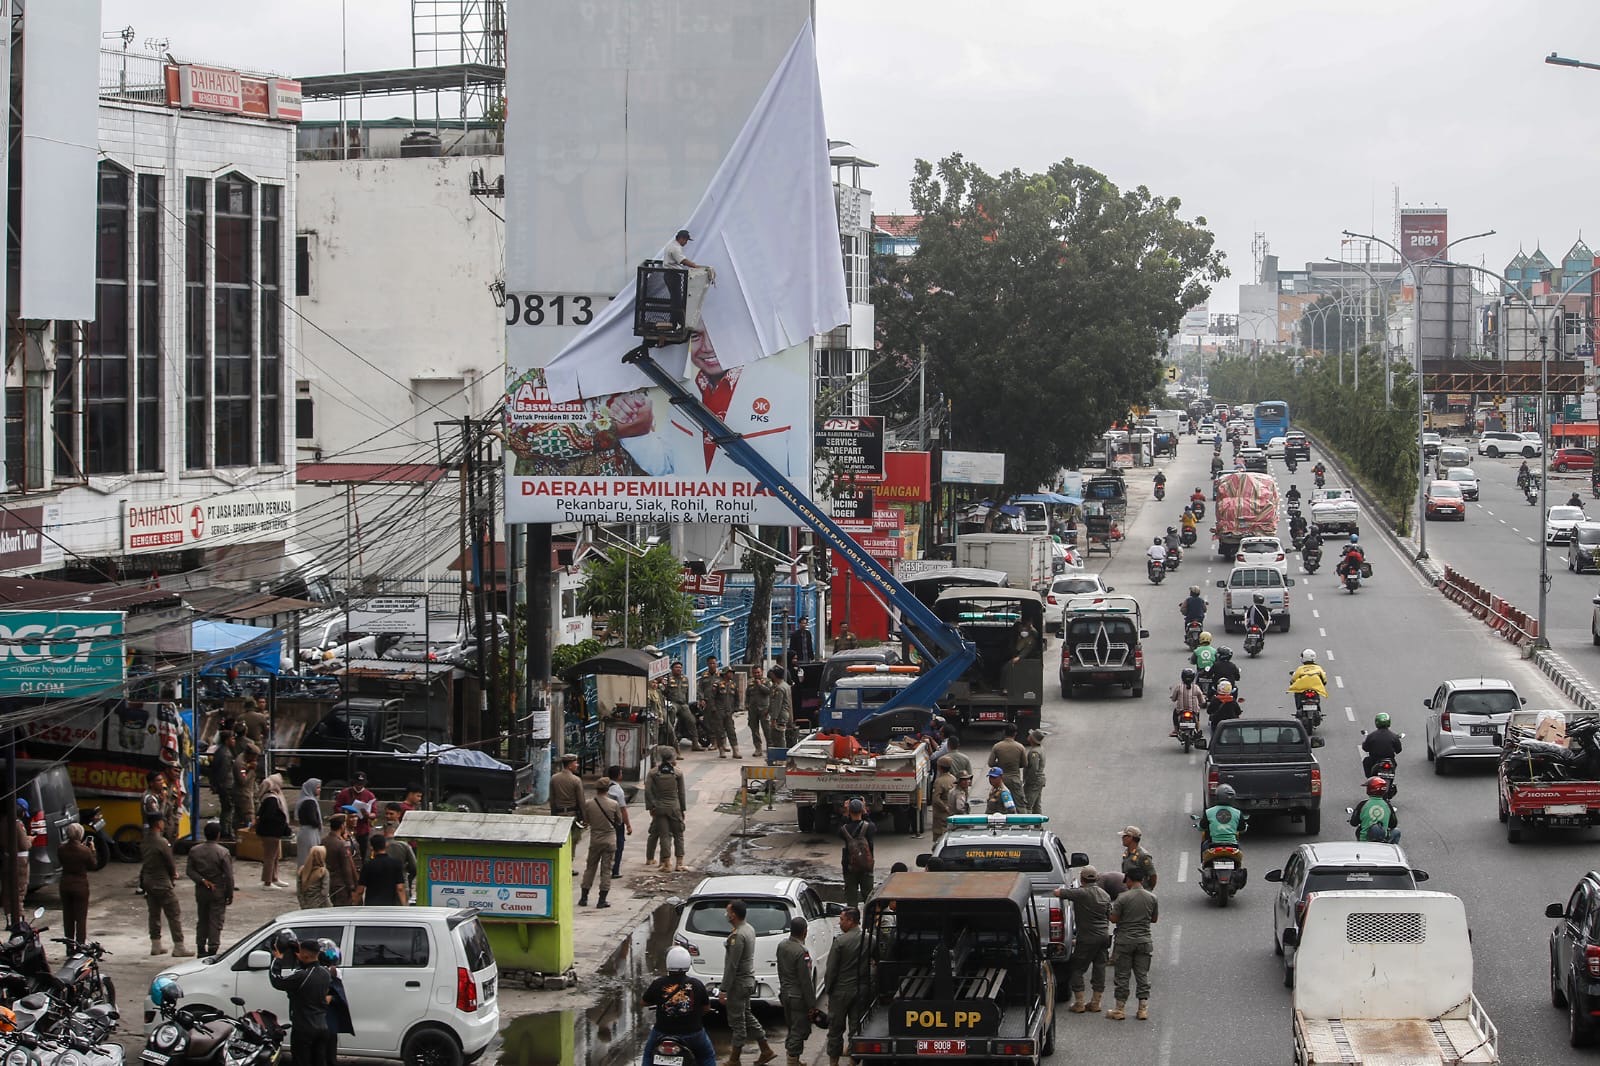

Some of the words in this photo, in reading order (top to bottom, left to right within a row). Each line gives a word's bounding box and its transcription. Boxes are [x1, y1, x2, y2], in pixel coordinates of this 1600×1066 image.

[192, 70, 239, 93] DAIHATSU
[1411, 235, 1438, 246] 2024
[506, 293, 593, 326] 0813
[518, 383, 549, 401] An
[517, 402, 581, 412] Baswedan
[750, 414, 769, 423] PKS
[826, 438, 857, 446] SERVICE
[838, 455, 865, 464] REPAIR
[521, 481, 607, 496] DAERAH
[613, 481, 726, 497] PEMILIHAN
[872, 485, 920, 497] UANGAN
[207, 506, 215, 519] PT
[217, 505, 232, 519] JASA
[233, 502, 264, 518] BARUTAMA
[265, 501, 292, 515] PERKASA
[557, 498, 631, 512] Pekanbaru,
[636, 498, 666, 512] Siak,
[671, 498, 708, 512] Rohil,
[716, 499, 758, 513] Rohul,
[129, 504, 183, 528] DAIHATSU
[565, 512, 611, 523] Dumai,
[616, 512, 679, 523] Bengkalis
[683, 512, 693, 523] &
[698, 512, 750, 524] Meranti
[778, 485, 797, 506] CALL
[799, 504, 831, 536] CENTER
[830, 533, 847, 551] PJU
[211, 523, 230, 536] SERVICE
[22, 530, 38, 550] Tour
[132, 535, 161, 547] BENGKEL
[162, 533, 182, 544] RESMI
[10, 664, 40, 675] explore
[42, 664, 72, 675] beyond
[430, 857, 490, 883] SERVICE
[494, 861, 550, 886] CENTER
[440, 887, 465, 895] ASUS
[501, 903, 532, 911] Canon
[905, 1010, 948, 1028] POL
[954, 1011, 981, 1028] PP
[918, 1041, 928, 1050] BM
[957, 1041, 966, 1050] TP
